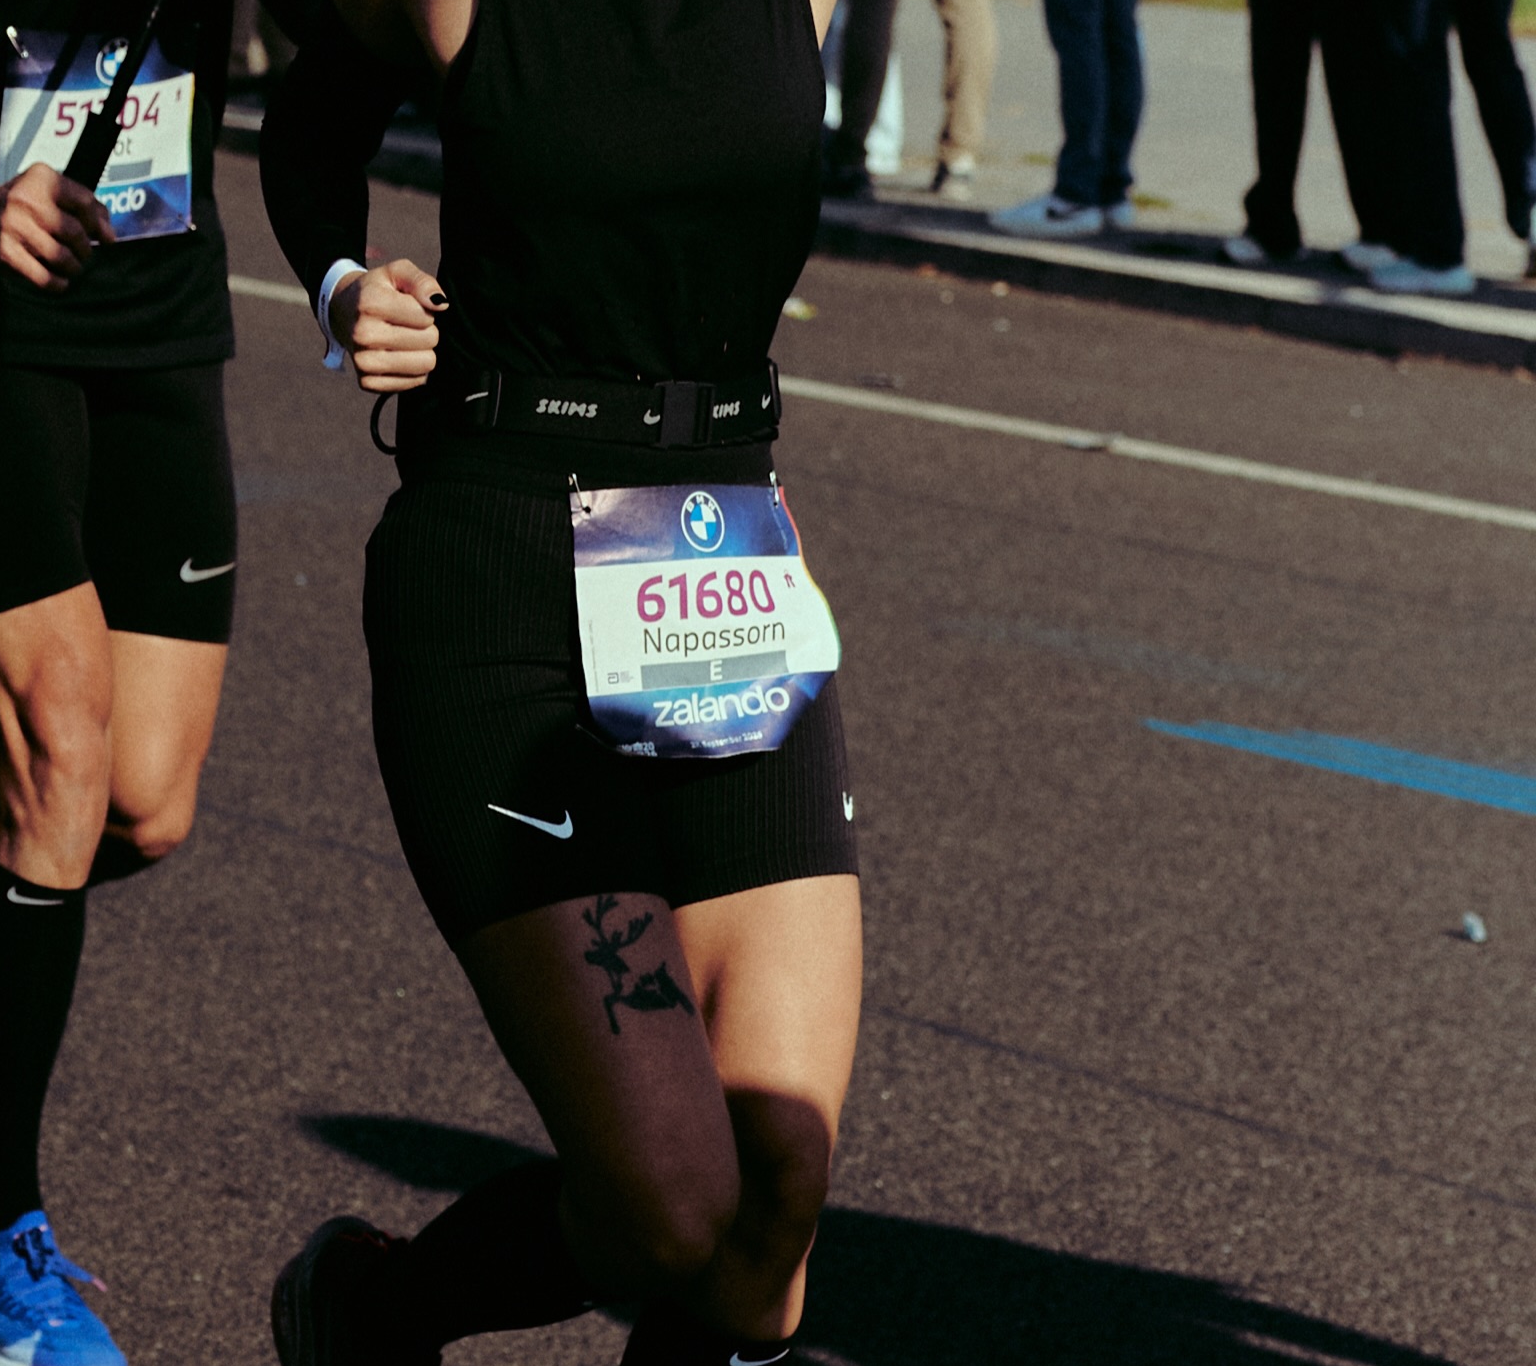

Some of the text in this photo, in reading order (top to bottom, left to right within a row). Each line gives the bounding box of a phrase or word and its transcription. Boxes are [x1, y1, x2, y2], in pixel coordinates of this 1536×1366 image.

[536, 398, 598, 418] SKIMS
[713, 400, 740, 419] KIMS
[685, 493, 716, 513] BMW
[637, 569, 775, 623] 61680
[643, 621, 786, 657] Napassorn
[709, 660, 723, 682] E
[653, 685, 790, 728] zalando
